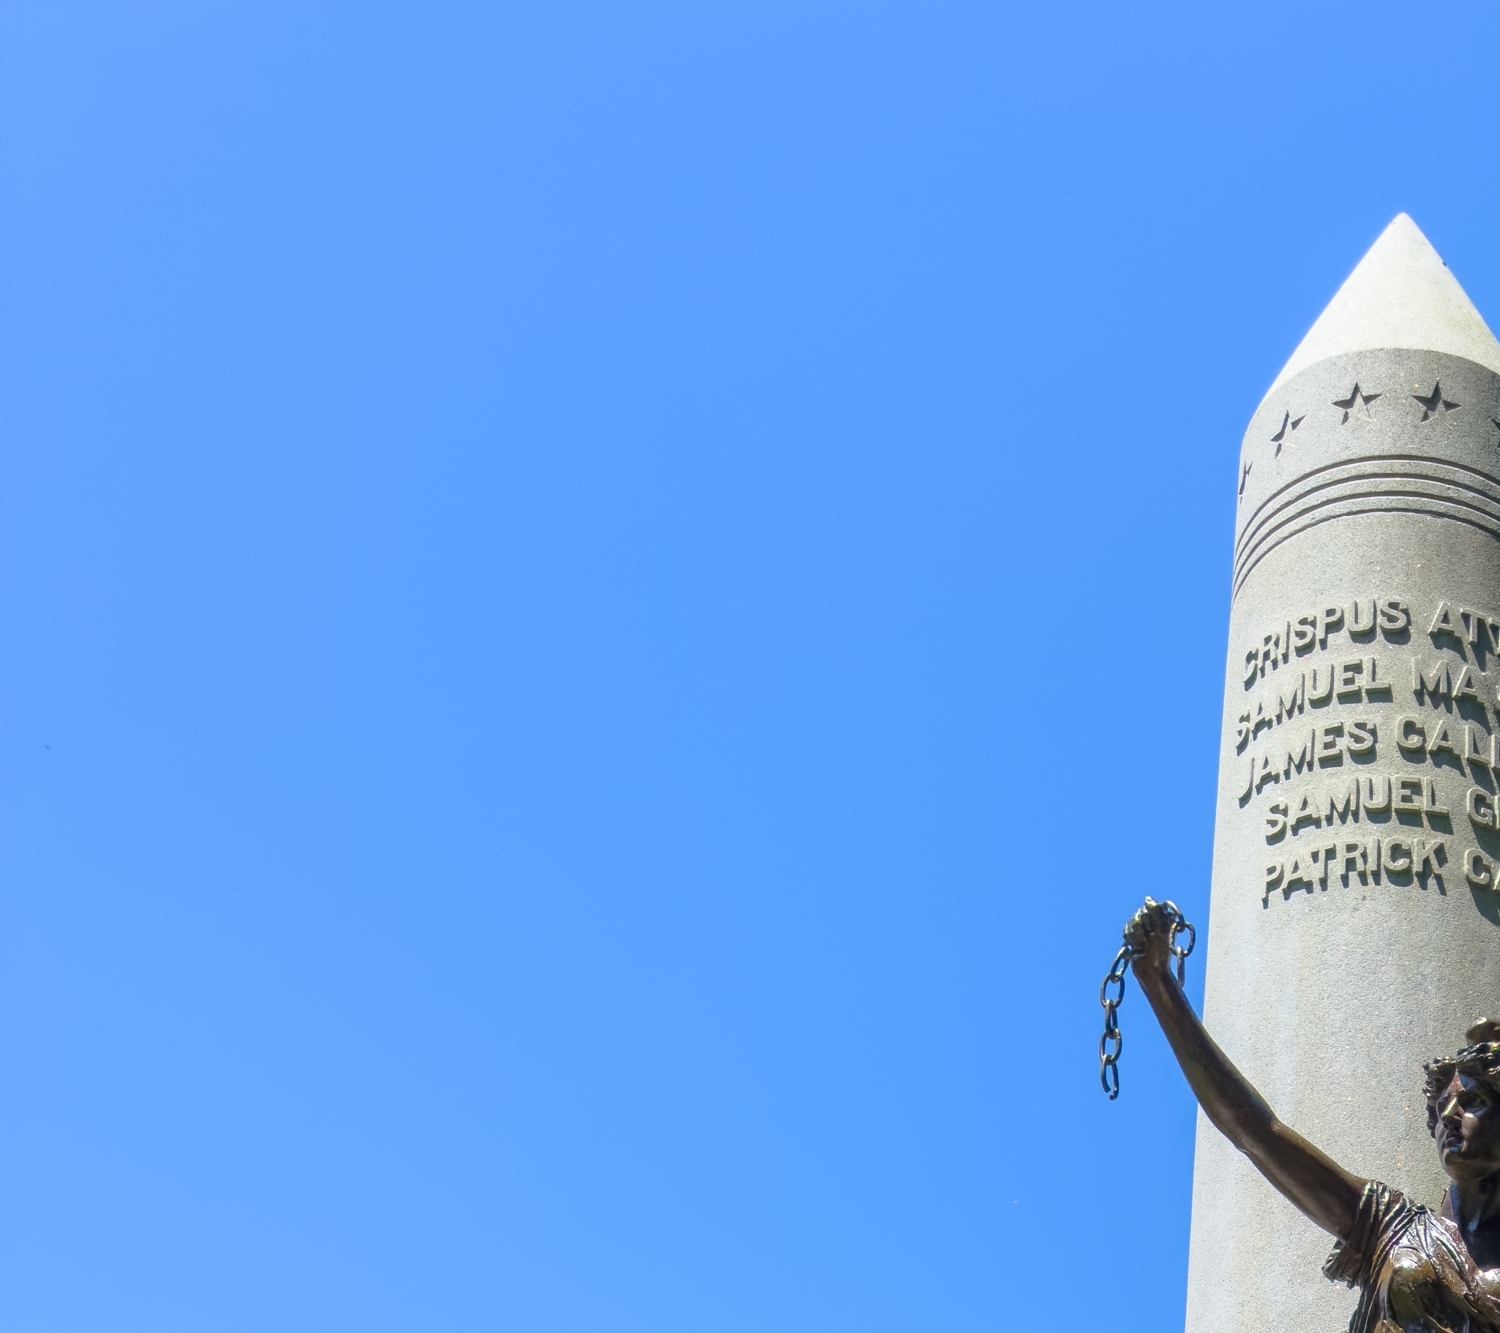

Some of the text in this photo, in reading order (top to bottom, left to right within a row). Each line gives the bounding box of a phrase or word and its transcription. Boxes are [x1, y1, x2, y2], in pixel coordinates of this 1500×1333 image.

[1243, 597, 1409, 684] CRISPUS
[1236, 656, 1391, 750] SAMUEL
[1238, 719, 1376, 803] JAMES
[1265, 776, 1450, 838] SAMUEL
[1262, 838, 1446, 904] PATRICK
